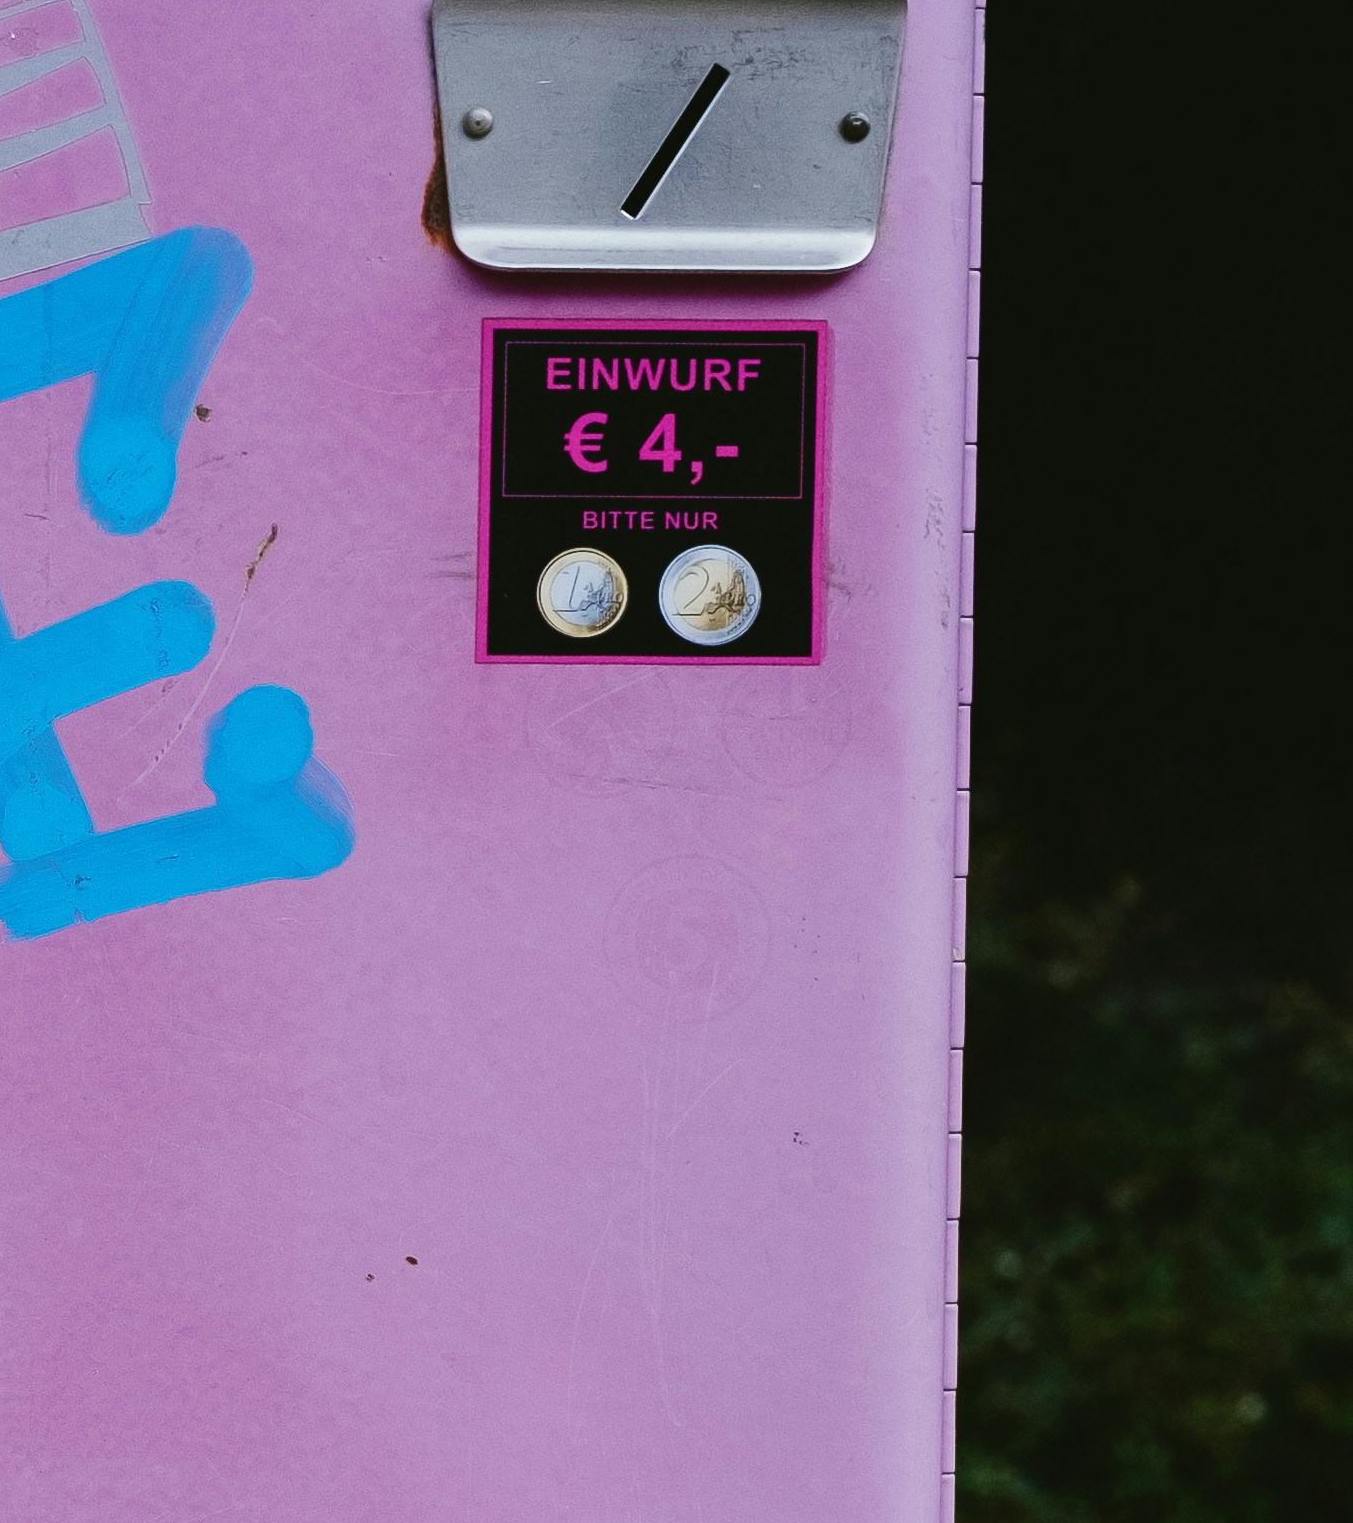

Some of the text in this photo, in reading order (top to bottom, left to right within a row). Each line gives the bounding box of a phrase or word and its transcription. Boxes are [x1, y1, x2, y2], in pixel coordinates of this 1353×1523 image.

[546, 358, 762, 391] EINWURF
[563, 412, 739, 485] € 4,-
[582, 511, 719, 530] BITTE NUR
